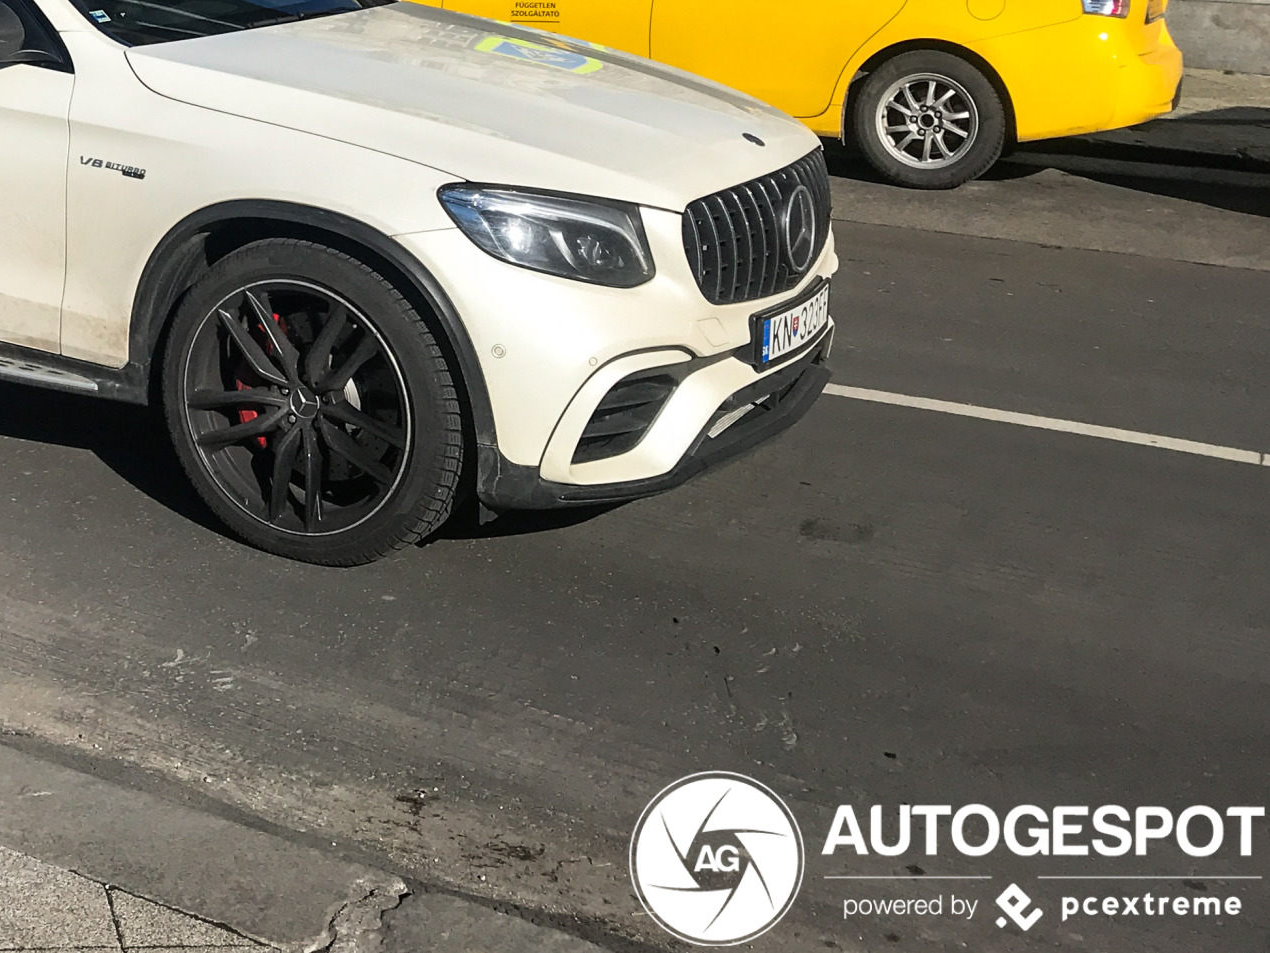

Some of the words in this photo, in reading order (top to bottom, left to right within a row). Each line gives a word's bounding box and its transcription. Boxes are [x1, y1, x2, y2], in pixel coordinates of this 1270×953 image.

[515, 1, 556, 9] FÜGGETLEN
[511, 9, 560, 18] SZOLGÁLTATÓ
[80, 155, 104, 168] V8
[105, 161, 147, 175] BITURBO
[772, 312, 793, 355] KN
